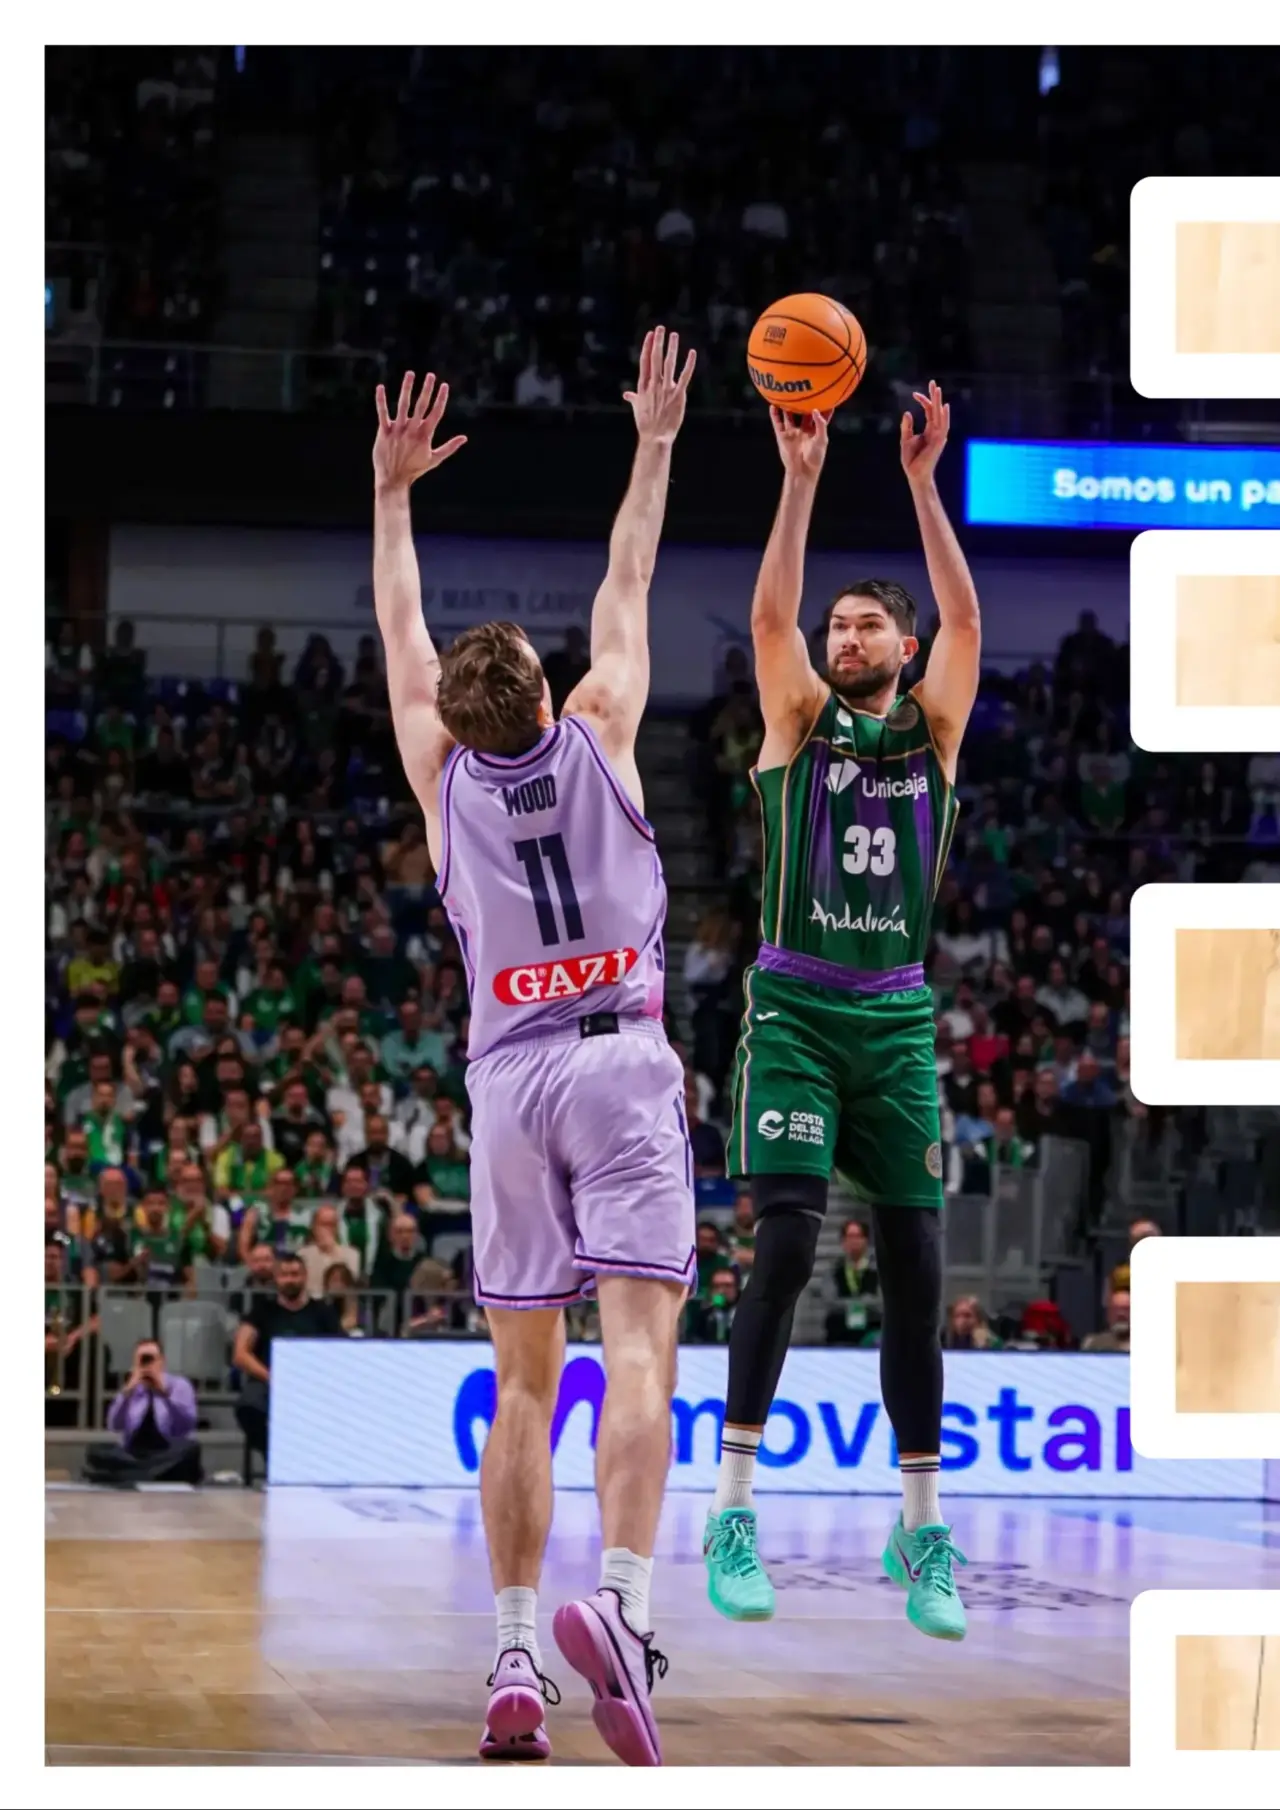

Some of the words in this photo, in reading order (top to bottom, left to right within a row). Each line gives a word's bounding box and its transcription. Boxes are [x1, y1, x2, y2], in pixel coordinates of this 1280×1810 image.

[1053, 467, 1175, 502] Somos
[1185, 479, 1232, 503] un
[502, 774, 557, 817] WOOD
[862, 773, 928, 800] Unicaja
[842, 825, 896, 876] 33
[514, 832, 585, 947] 11
[808, 897, 910, 938] Andalucía
[789, 1122, 808, 1133] DEL
[810, 1125, 825, 1137] SOL
[790, 1111, 825, 1127] COSTA
